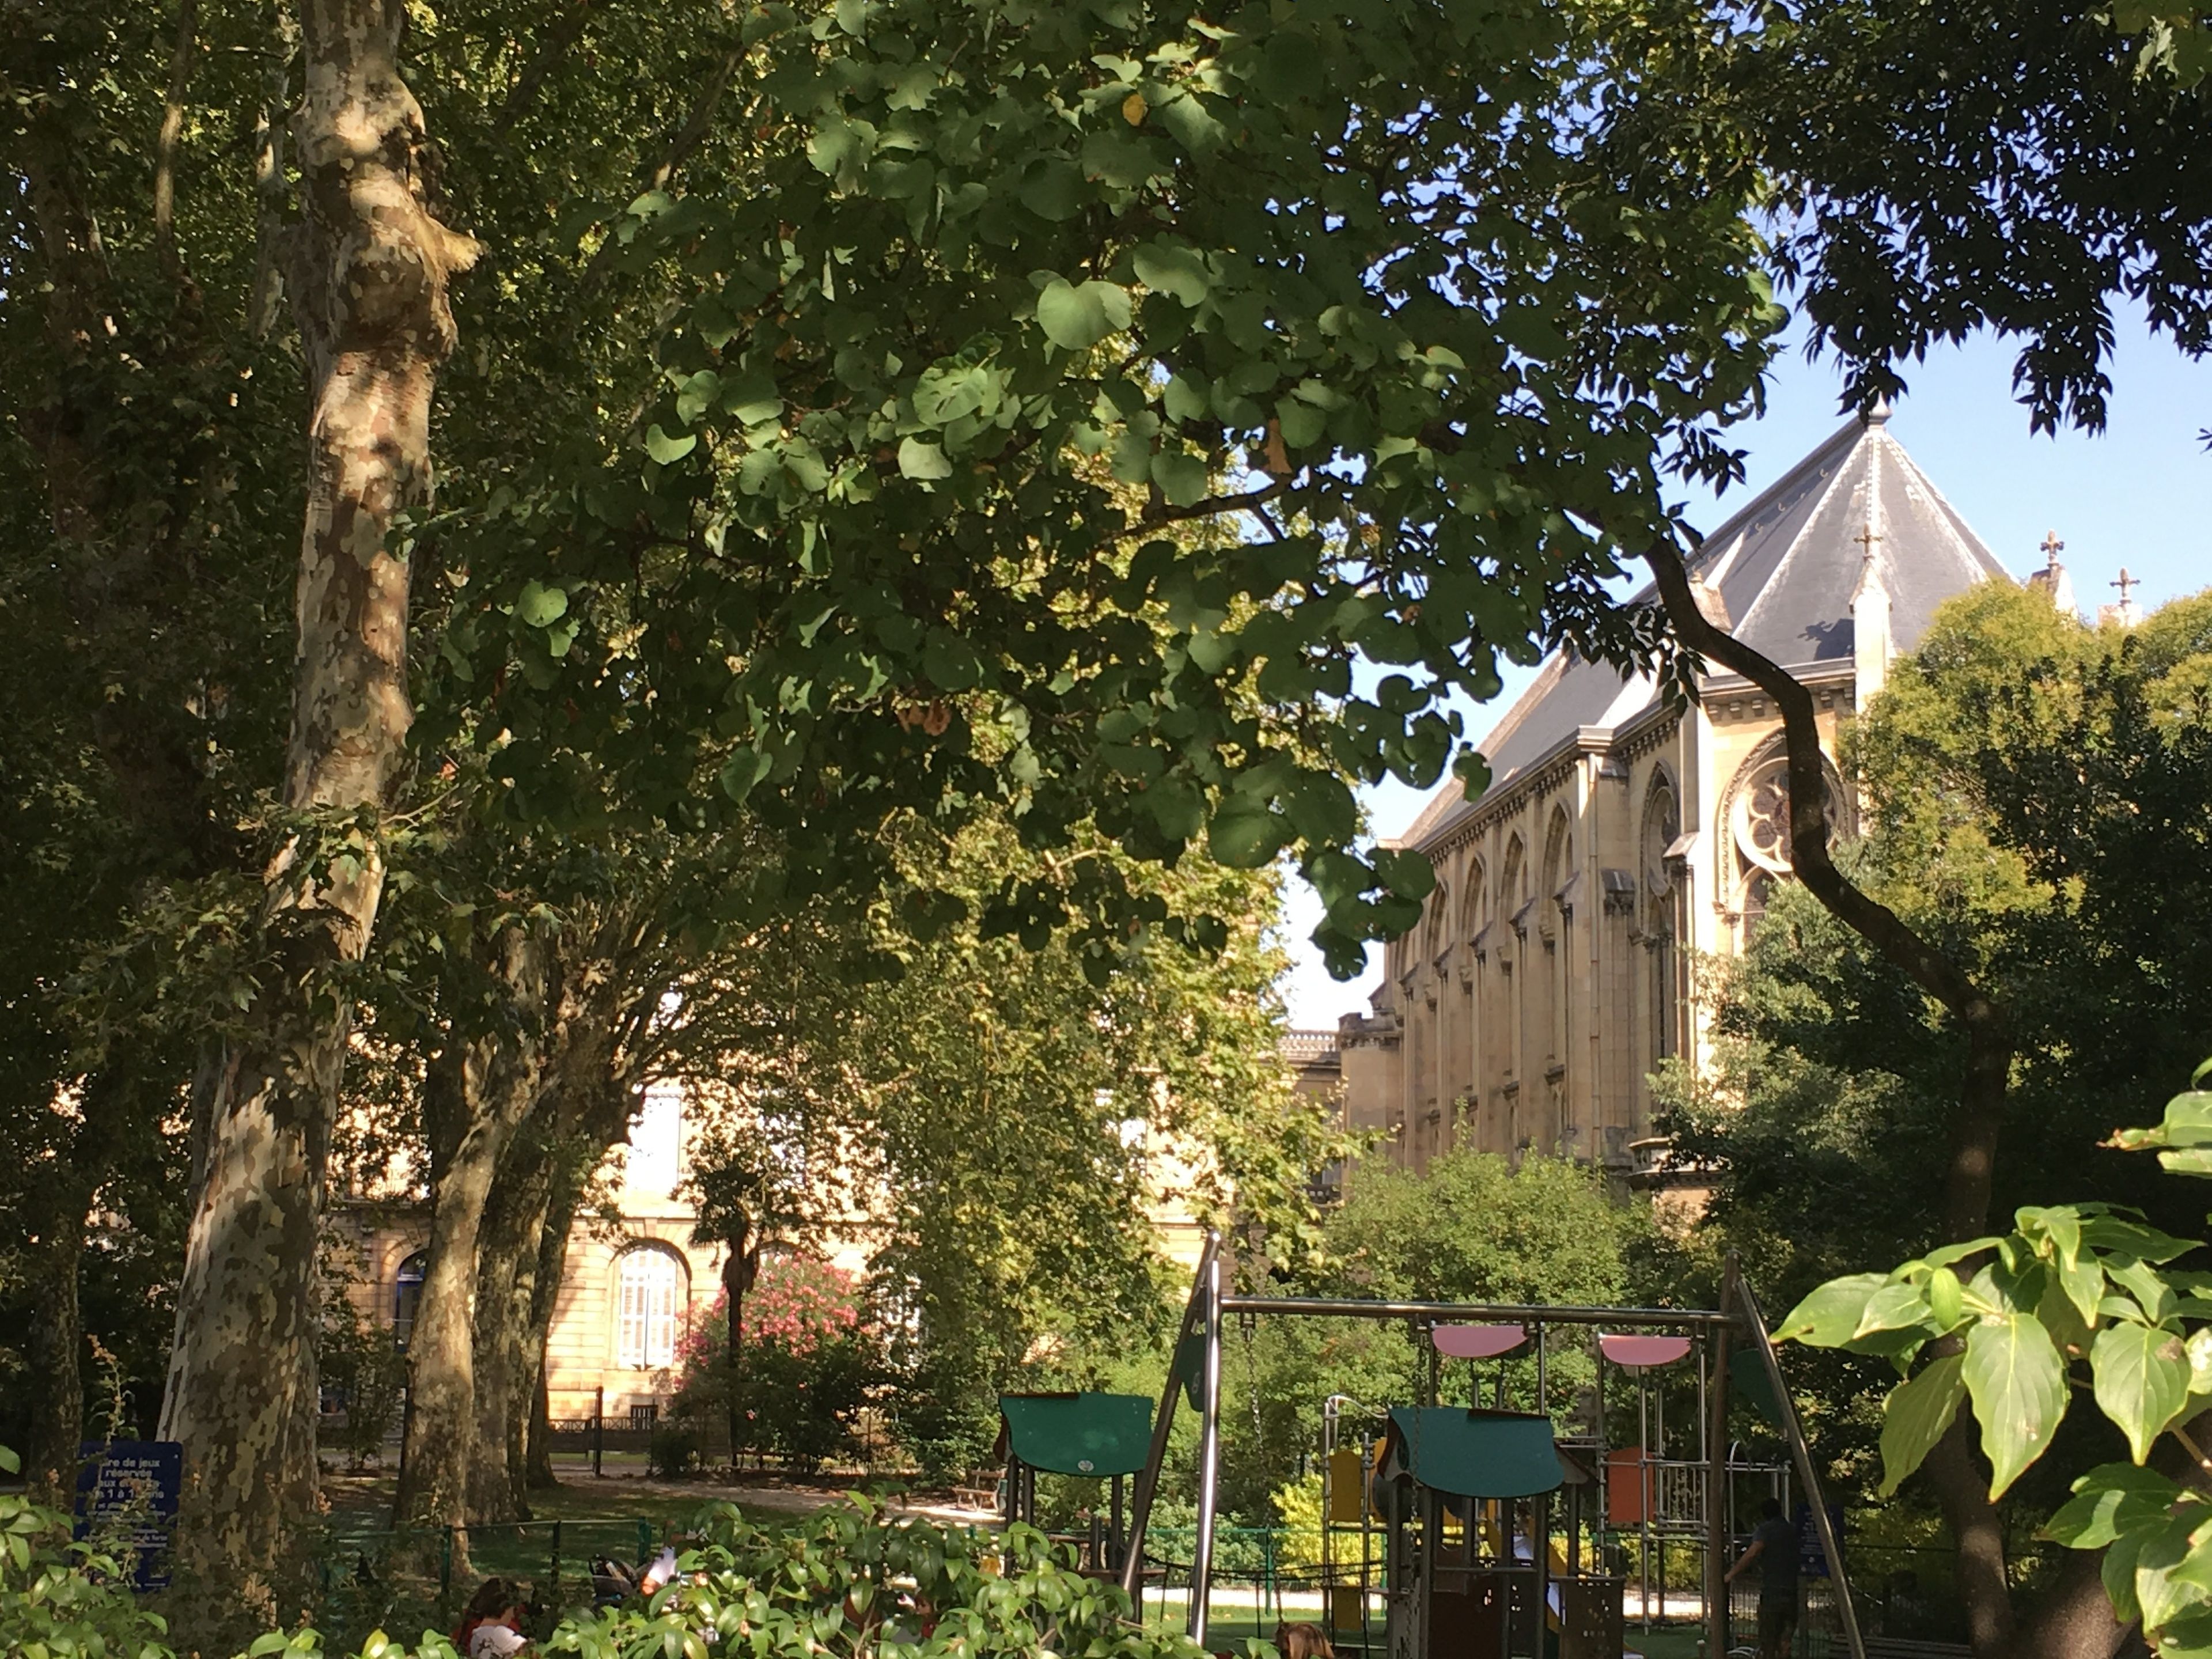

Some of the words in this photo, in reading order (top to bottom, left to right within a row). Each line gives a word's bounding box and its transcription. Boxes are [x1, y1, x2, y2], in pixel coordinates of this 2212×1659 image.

[122, 1457, 136, 1467] de
[139, 1457, 160, 1469] jeux
[105, 1468, 153, 1478] réservée
